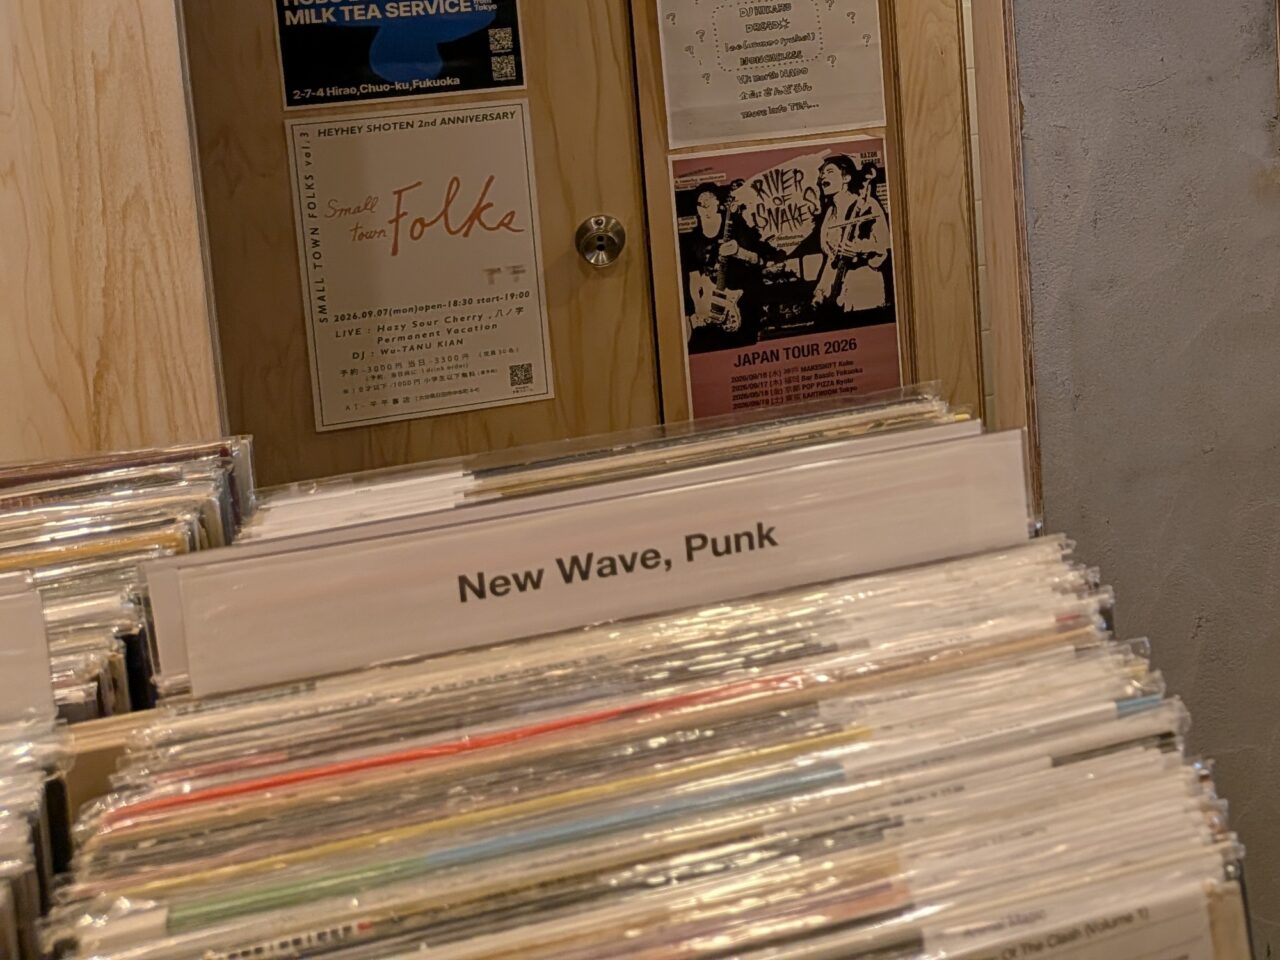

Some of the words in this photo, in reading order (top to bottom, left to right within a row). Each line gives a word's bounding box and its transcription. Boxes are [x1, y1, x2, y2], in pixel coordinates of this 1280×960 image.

[284, 7, 337, 26] MILK
[339, 3, 382, 21] TEA
[473, 4, 498, 12] Tokyo
[292, 88, 325, 100] 2-7-4
[317, 125, 364, 138] HEYHEY
[366, 120, 415, 133] SHOTEN
[417, 117, 437, 128] 2nd
[439, 110, 517, 125] ANNIVERSARY
[304, 174, 318, 218] FOLKS
[750, 167, 805, 201] RIVER
[324, 196, 379, 218] Small
[750, 185, 822, 234] SNAKES
[772, 193, 792, 206] OF
[388, 174, 524, 257] Folks
[350, 222, 388, 242] town
[310, 227, 324, 269] TOWN
[314, 277, 329, 324] SMALL
[476, 290, 530, 304] start-19:00
[335, 327, 362, 338] LIVE
[377, 323, 407, 333] Hazy
[411, 319, 439, 328] Sour
[444, 313, 483, 324] Cherry
[377, 330, 441, 344] Permanent
[446, 323, 498, 335] Vacation
[352, 351, 365, 361] DJ
[734, 349, 780, 368] JAPAN
[783, 343, 820, 361] TOUR
[823, 338, 858, 354] 2026
[801, 382, 815, 390] POP
[816, 380, 836, 388] PIZZA
[457, 566, 545, 603] New
[555, 546, 673, 585] Wave,
[683, 521, 779, 563] Punk
